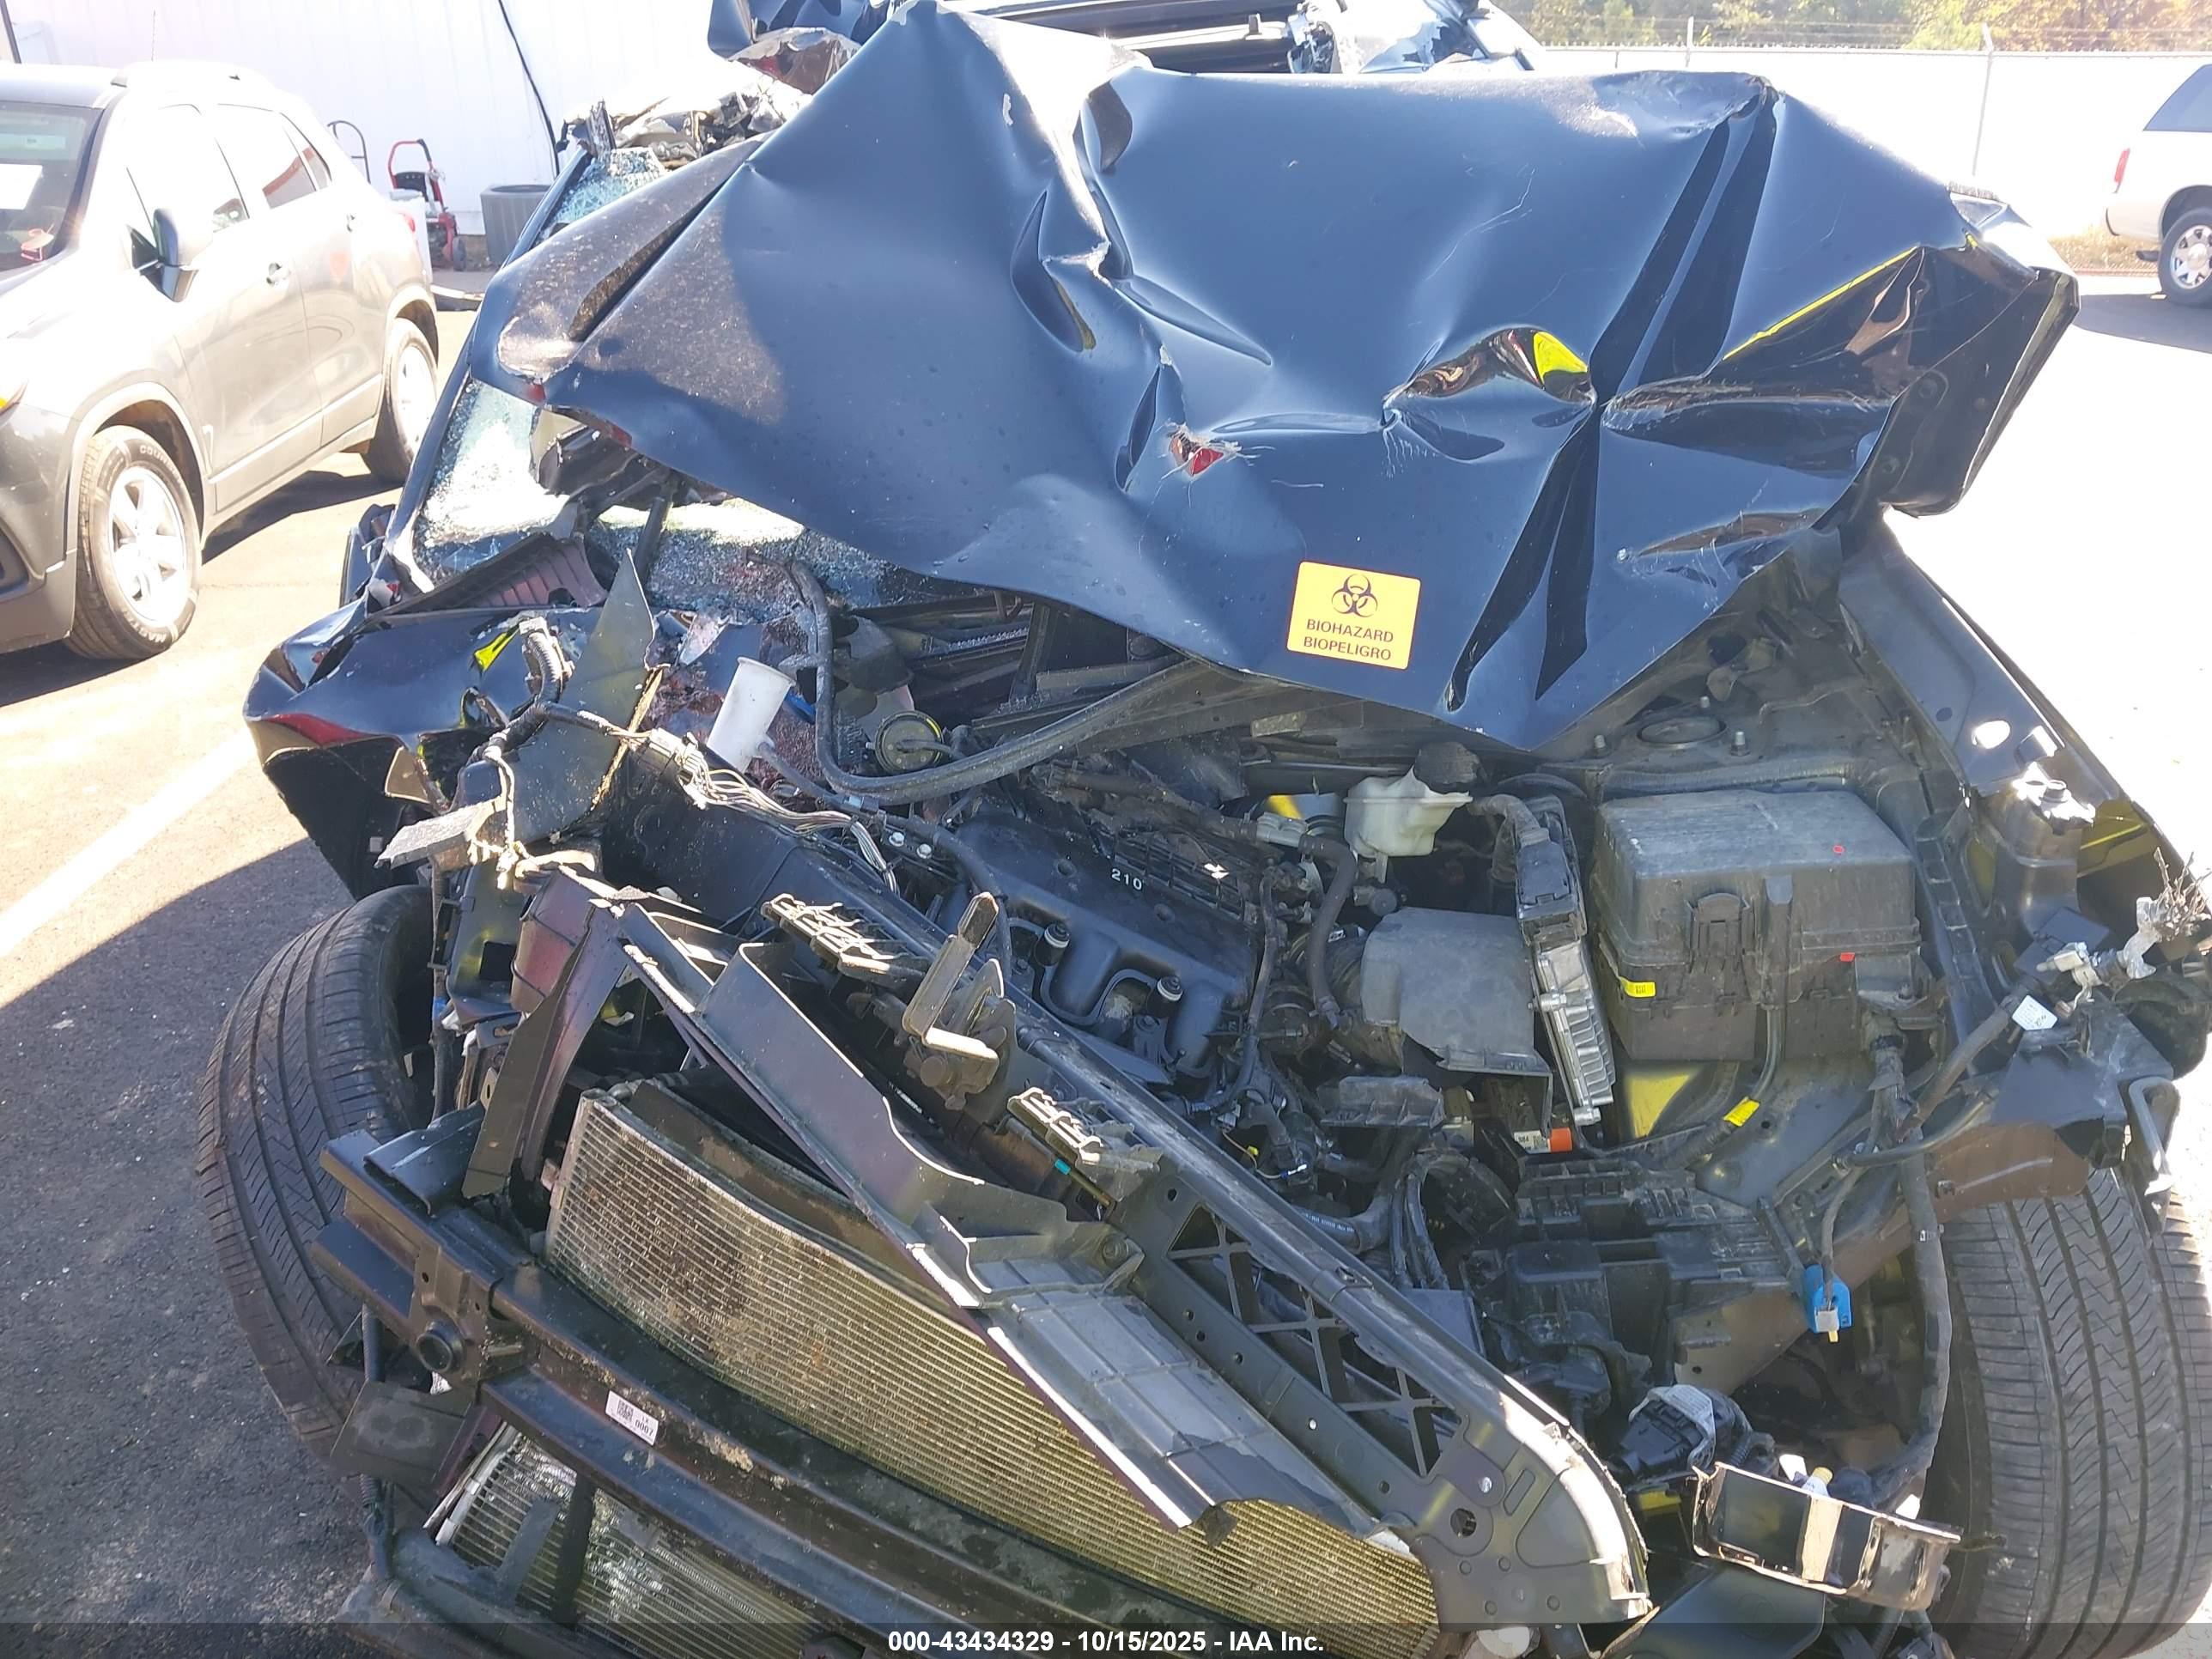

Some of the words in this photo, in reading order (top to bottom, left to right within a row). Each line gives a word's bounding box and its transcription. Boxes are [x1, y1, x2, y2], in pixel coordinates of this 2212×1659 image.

[1306, 619, 1393, 642] BIOHAZARD
[1304, 636, 1391, 660] BIOPELIGRO
[1111, 868, 1142, 890] 210
